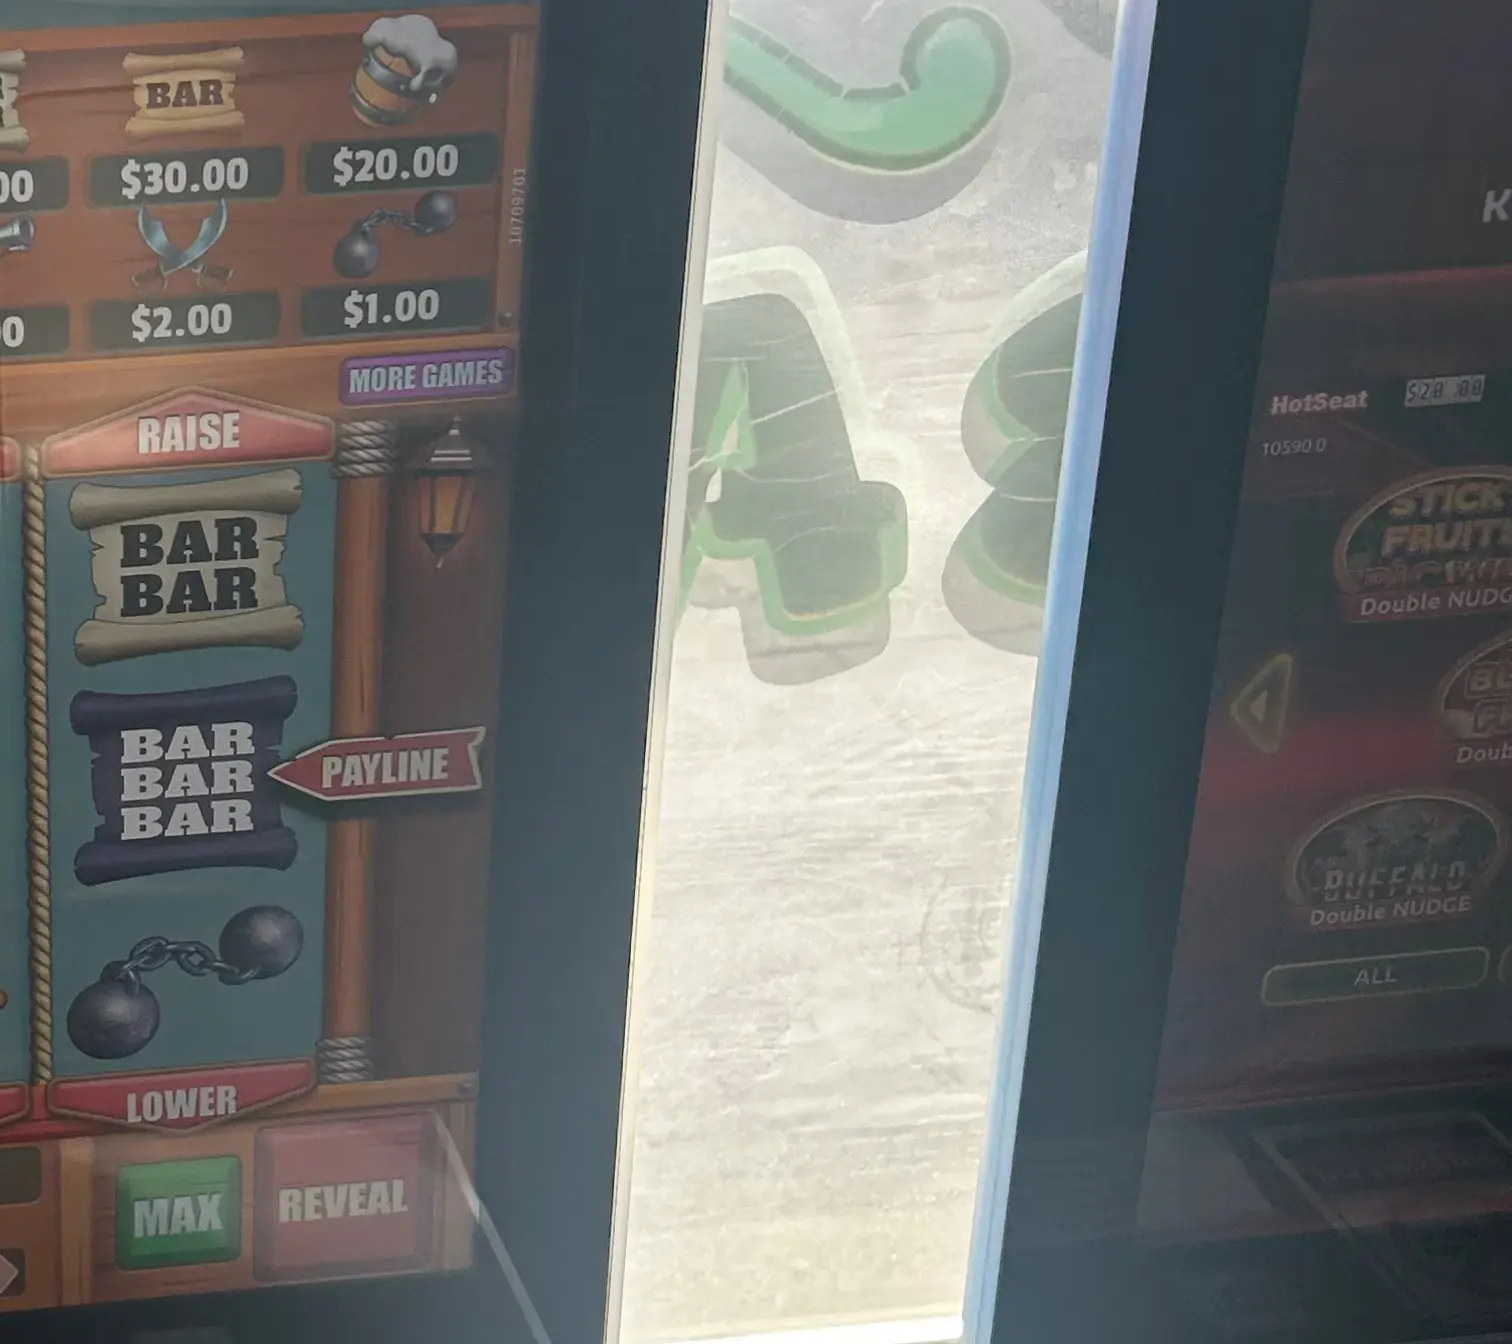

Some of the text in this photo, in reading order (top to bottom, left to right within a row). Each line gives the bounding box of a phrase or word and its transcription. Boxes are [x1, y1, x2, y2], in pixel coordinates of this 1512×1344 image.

[146, 79, 225, 109] BAR
[121, 158, 249, 199] $30.00
[333, 144, 458, 186] $20.00
[509, 169, 526, 244] 10709701
[132, 303, 232, 342] $2.00
[344, 289, 440, 328] $1.00
[349, 359, 503, 393] MORE GAMES
[1271, 390, 1368, 415] HotSeat
[137, 412, 241, 454] RAISE
[120, 516, 259, 568] BAR
[120, 567, 259, 617] BAR
[1360, 590, 1441, 616] Double
[120, 721, 255, 763] BAR
[120, 760, 255, 802] BAR
[322, 748, 448, 788] PAYLINE
[120, 799, 255, 840] BAR
[1310, 896, 1472, 926] Double NUDGE
[1354, 967, 1399, 985] ALL
[126, 1085, 238, 1123] LOWER
[133, 1193, 223, 1238] MAX
[279, 1179, 408, 1224] REVEAL
